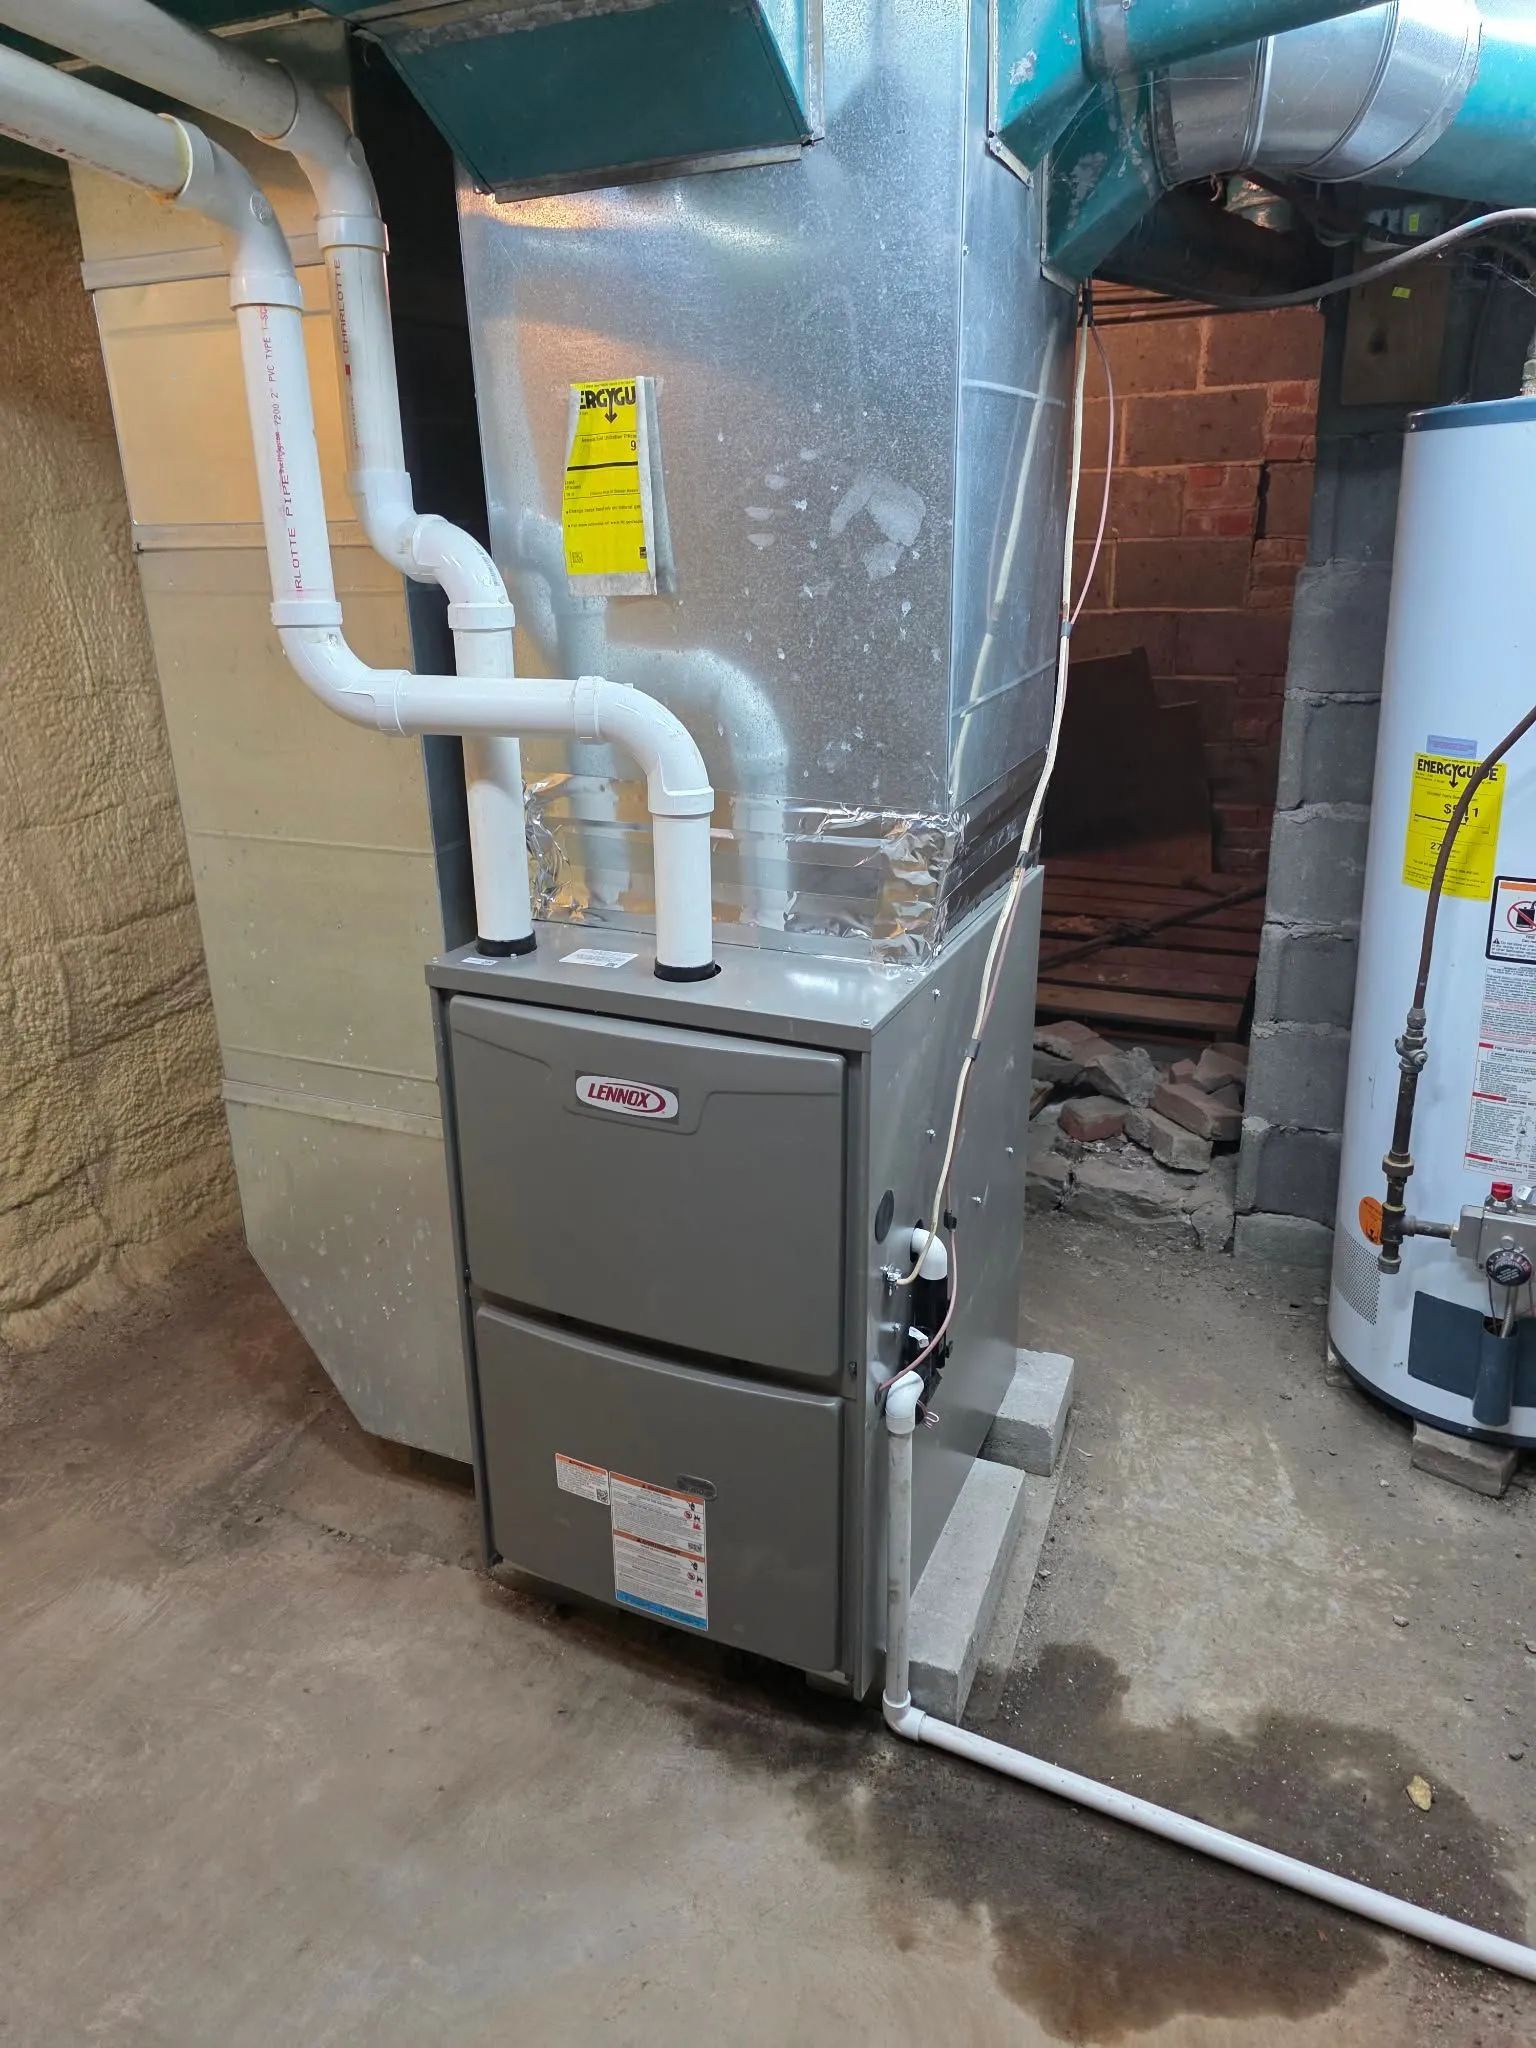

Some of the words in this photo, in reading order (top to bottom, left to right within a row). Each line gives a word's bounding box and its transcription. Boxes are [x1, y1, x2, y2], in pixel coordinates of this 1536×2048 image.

[333, 259, 350, 354] CHARLOTTE
[263, 337, 273, 360] TYPE
[266, 364, 276, 382] PVC
[281, 475, 293, 517] PIPE
[587, 1082, 652, 1109] LENNOX
